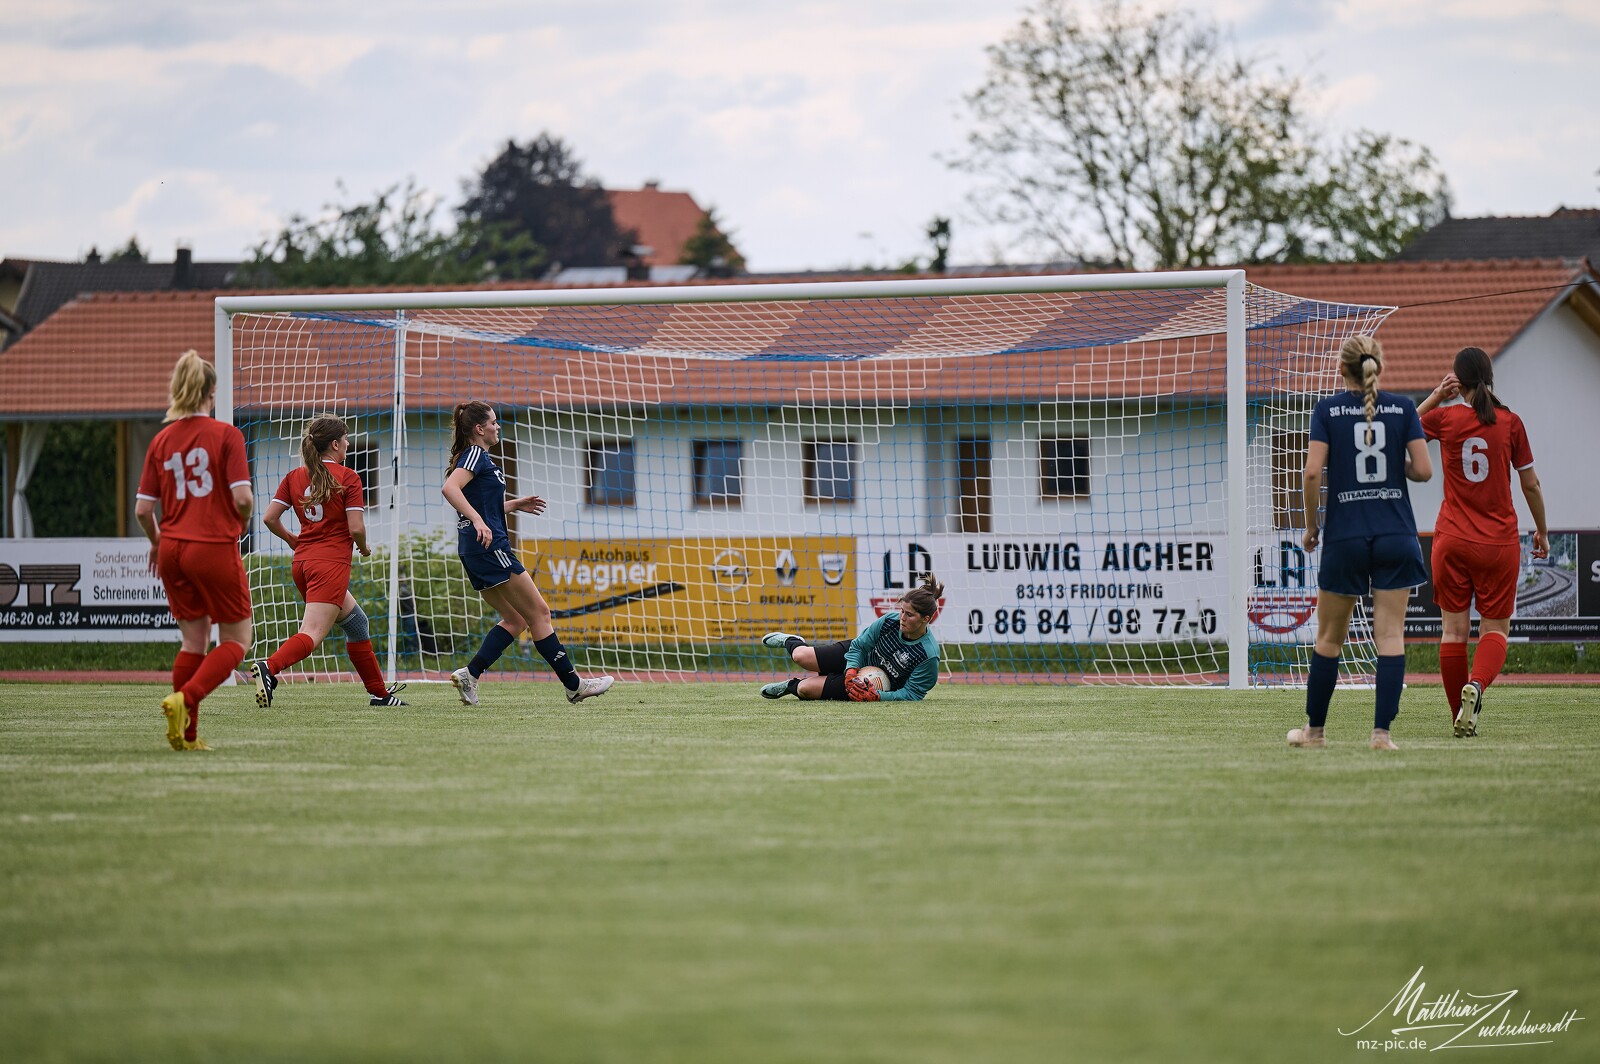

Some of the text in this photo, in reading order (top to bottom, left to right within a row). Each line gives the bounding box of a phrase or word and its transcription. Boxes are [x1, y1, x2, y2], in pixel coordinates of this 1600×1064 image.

[1329, 405, 1341, 417] SG
[1354, 421, 1387, 483] 8
[1461, 436, 1489, 483] 6
[163, 447, 214, 500] 13
[580, 548, 650, 562] Autohaus
[967, 542, 1214, 572] LUDWIG AICHER
[92, 565, 117, 579] nach
[547, 560, 657, 592] Wagner
[93, 585, 168, 600] Schreinerei Mo
[1016, 583, 1163, 599] 83413 FRIDOLFING
[760, 595, 816, 605] RENAULT
[36, 611, 55, 625] od.
[58, 611, 80, 625] 324
[89, 611, 178, 628] www.motz-gdb
[968, 609, 983, 634] 0
[994, 609, 1026, 634] 86
[1038, 609, 1071, 634] 84
[1107, 609, 1141, 634] 98
[1152, 608, 1217, 634] 77-0
